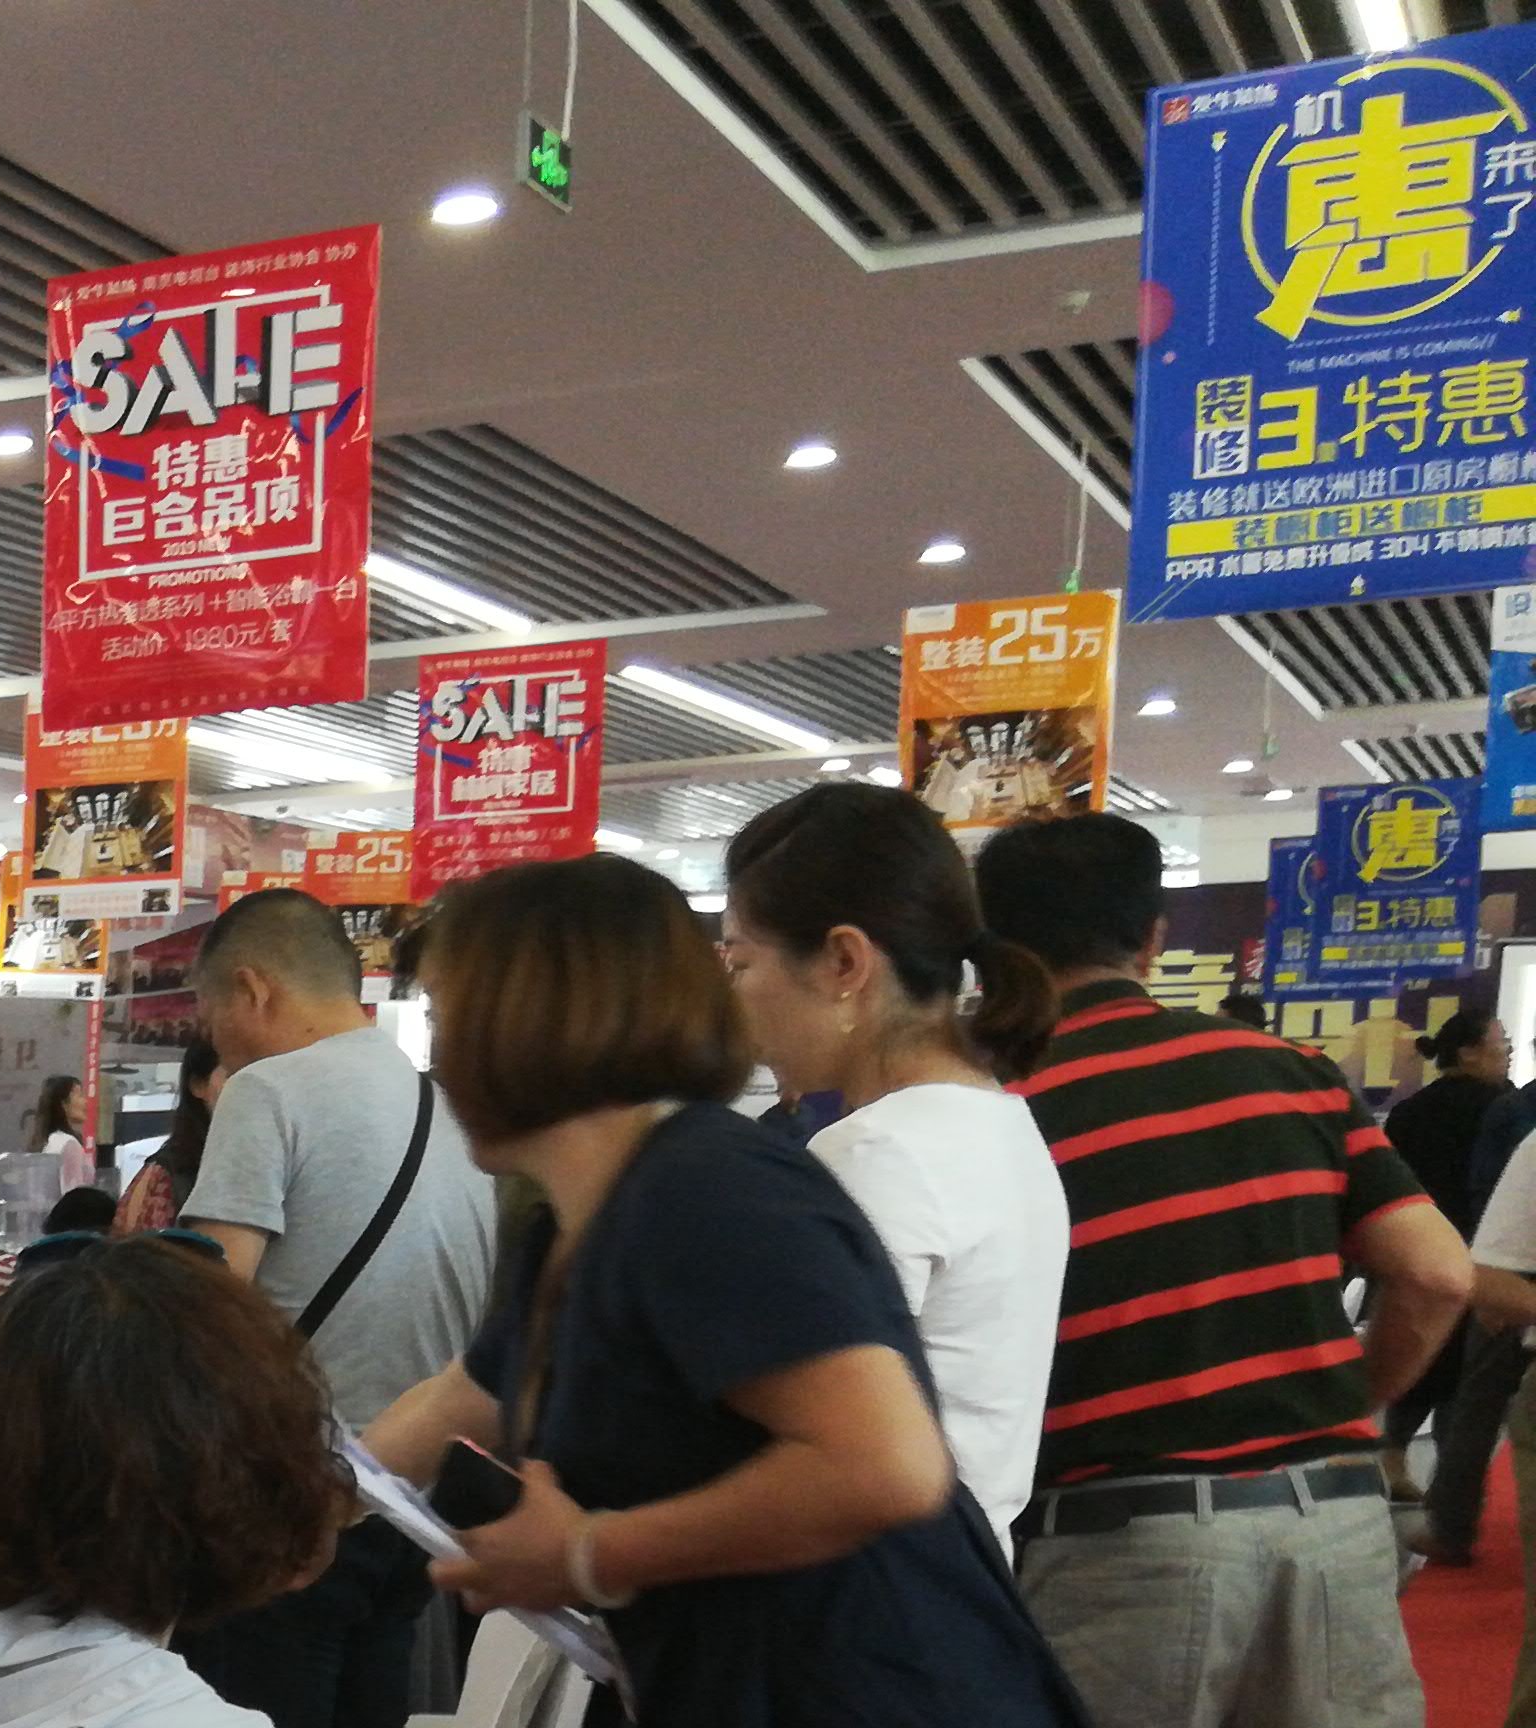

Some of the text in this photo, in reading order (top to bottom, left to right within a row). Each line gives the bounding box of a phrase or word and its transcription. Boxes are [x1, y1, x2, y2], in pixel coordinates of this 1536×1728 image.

[1292, 88, 1346, 139] 机
[1255, 91, 1510, 342] 惠
[69, 302, 344, 437] SALE
[1194, 375, 1252, 480] 装修
[151, 433, 250, 491] 特惠
[1165, 558, 1216, 583] PPR
[1377, 533, 1429, 561] 304
[100, 630, 168, 662] 活动价
[431, 674, 588, 745] SALE
